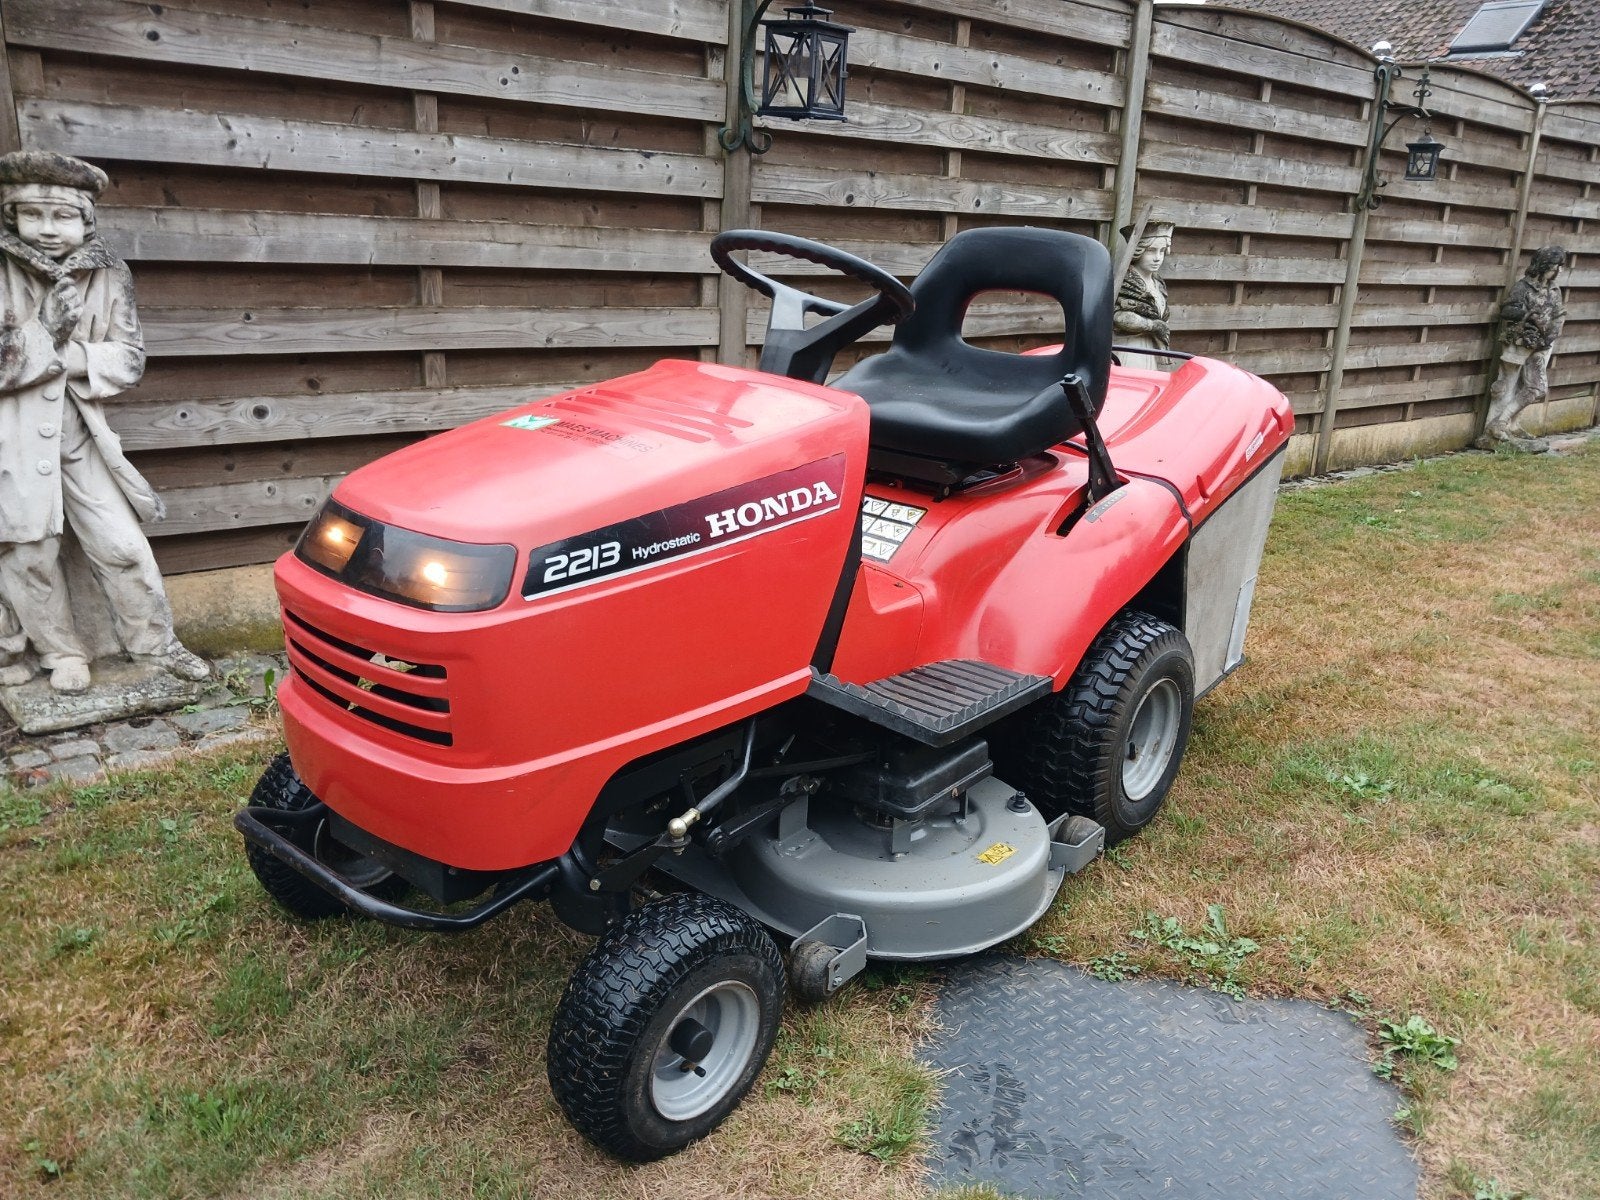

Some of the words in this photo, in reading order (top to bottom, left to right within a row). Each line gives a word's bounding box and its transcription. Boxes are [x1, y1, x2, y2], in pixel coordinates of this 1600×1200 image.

[543, 541, 621, 584] 2213
[632, 532, 701, 560] Hydrostatic
[705, 481, 837, 538] HONDA
